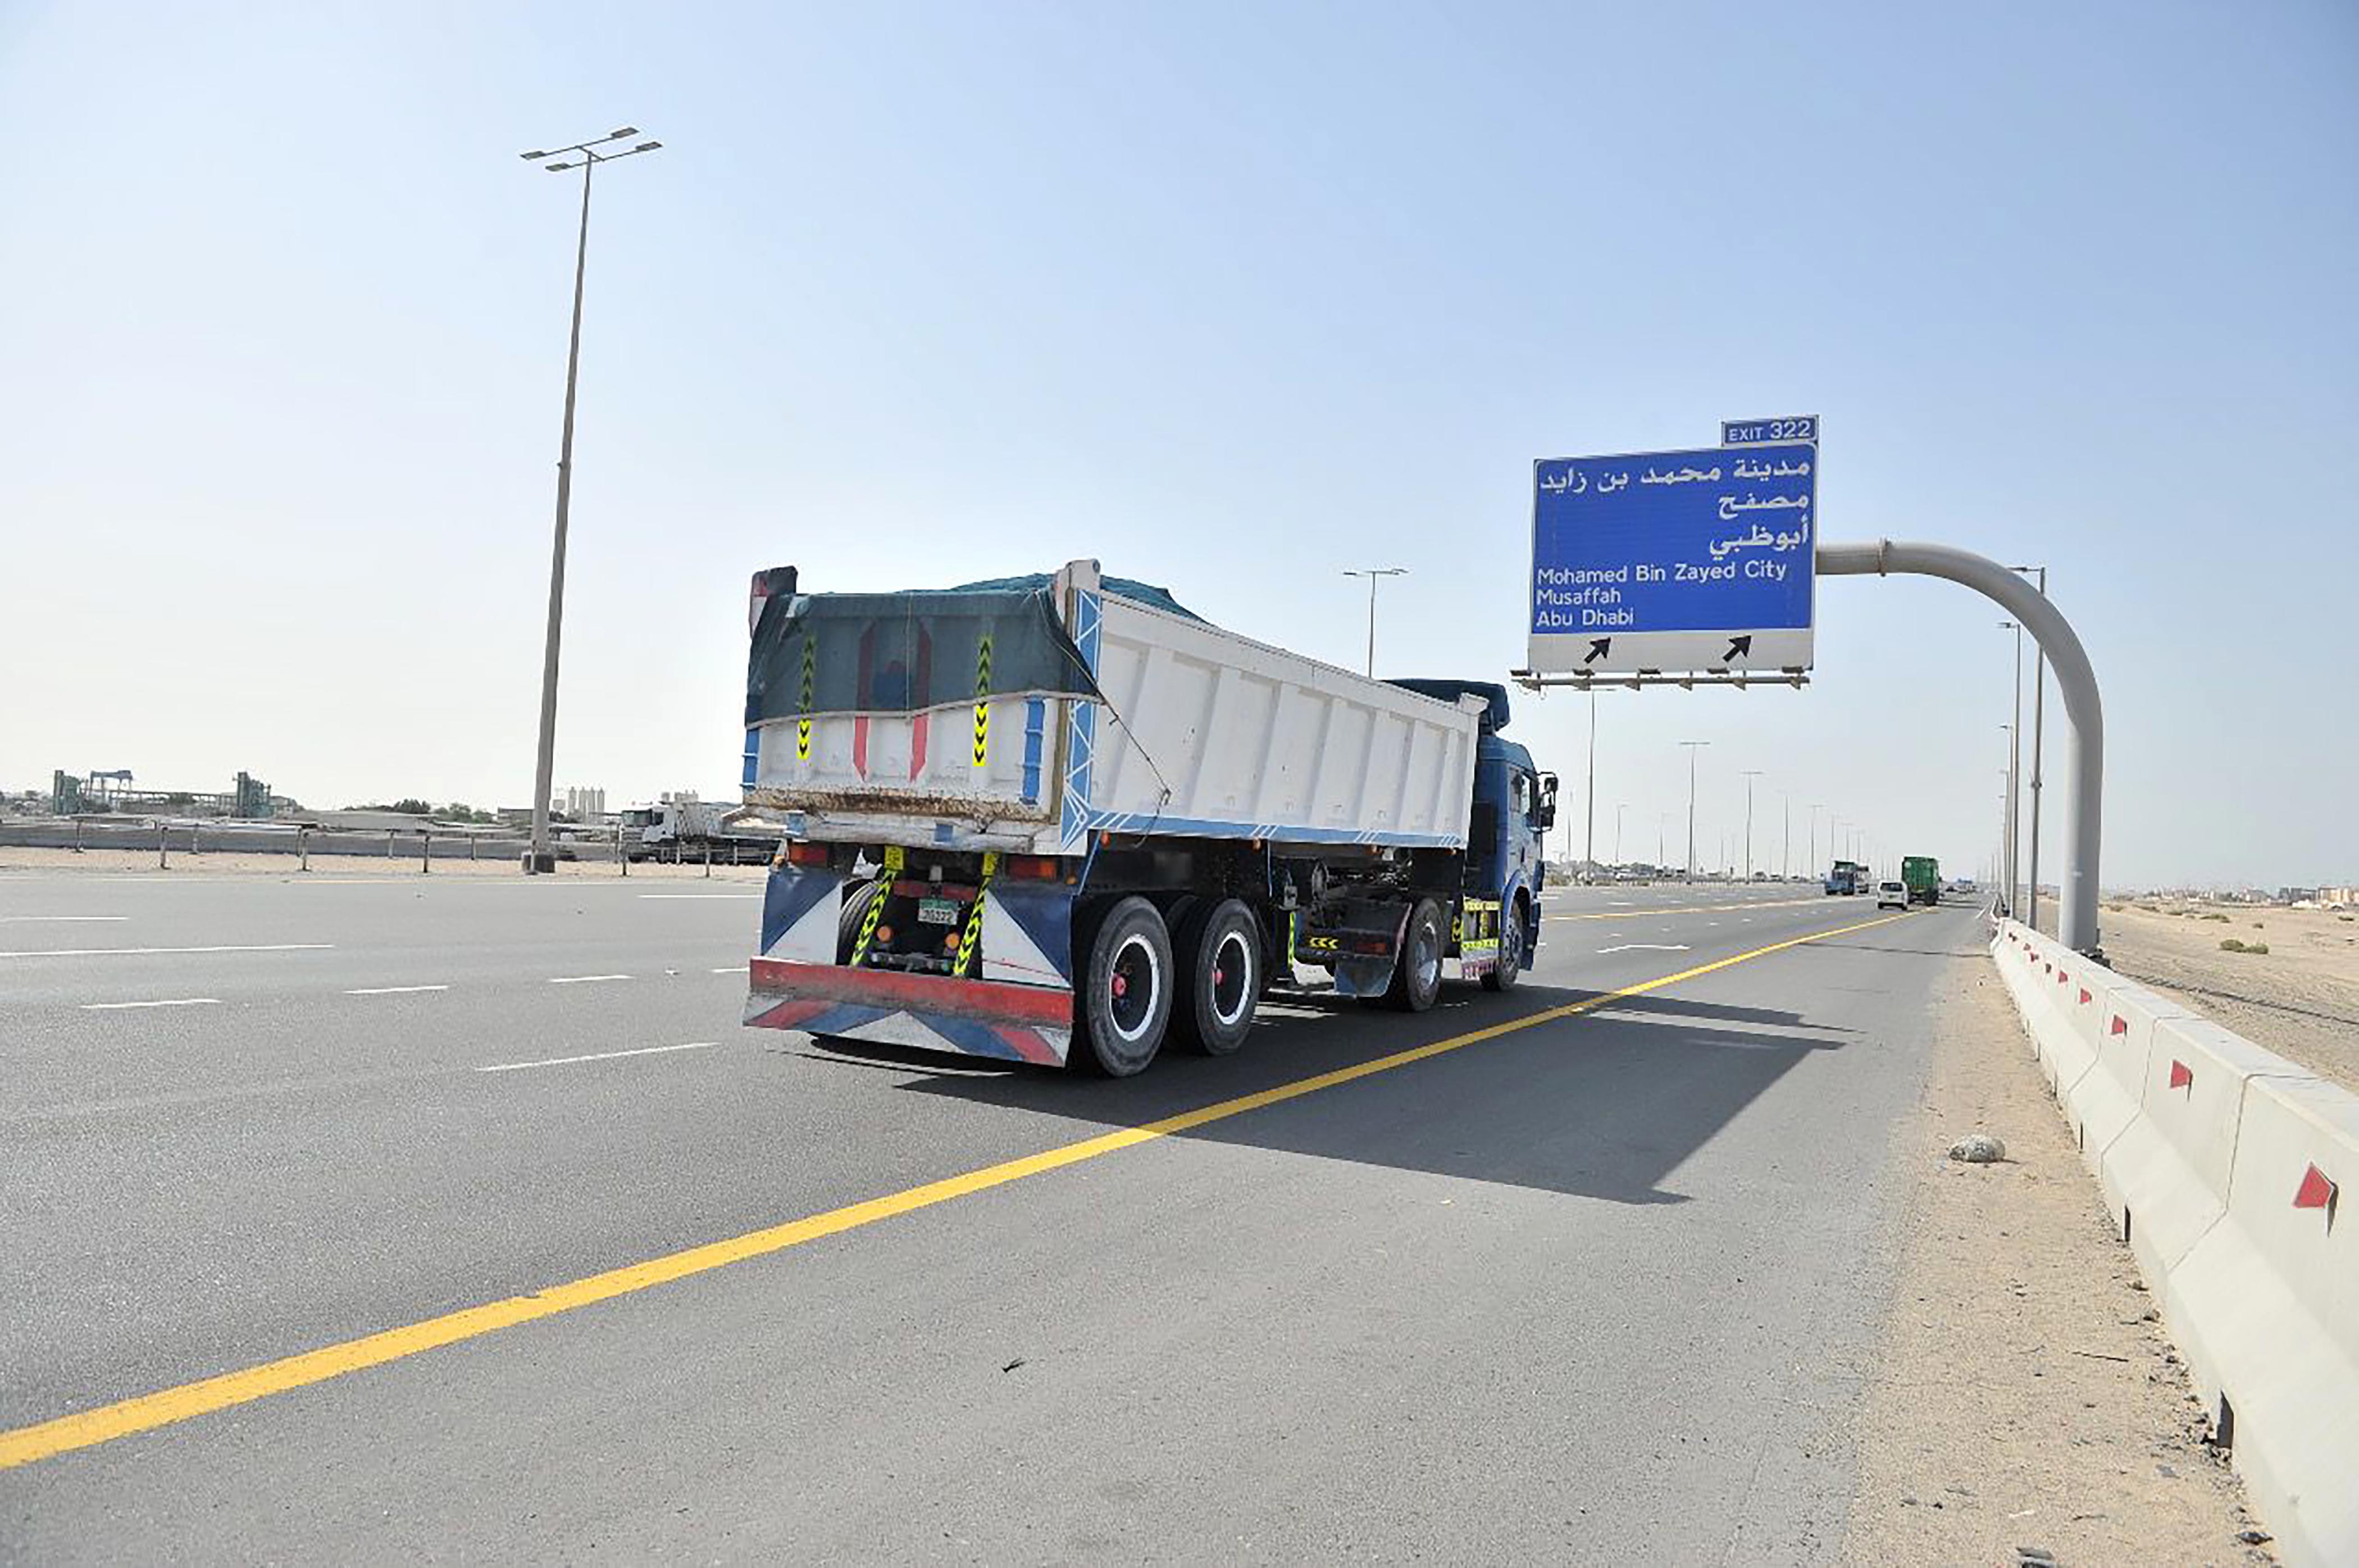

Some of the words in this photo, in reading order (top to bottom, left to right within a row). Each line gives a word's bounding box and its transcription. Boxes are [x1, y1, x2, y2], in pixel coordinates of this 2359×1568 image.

[1729, 427, 1763, 441] EXIT
[1770, 420, 1810, 439] 322
[1540, 467, 1588, 494] زايد
[1597, 470, 1629, 493] بن
[1641, 466, 1722, 485] محمد
[1733, 458, 1810, 482] مدينة
[1718, 492, 1809, 519] مصفح
[1537, 566, 1628, 585] Mohamed
[1636, 563, 1666, 582] Bin
[1674, 561, 1736, 583] Zayed
[1745, 560, 1787, 581] City
[1536, 587, 1621, 605] Musaffah
[1536, 610, 1573, 627] Abu
[1582, 607, 1634, 626] Dhabi
